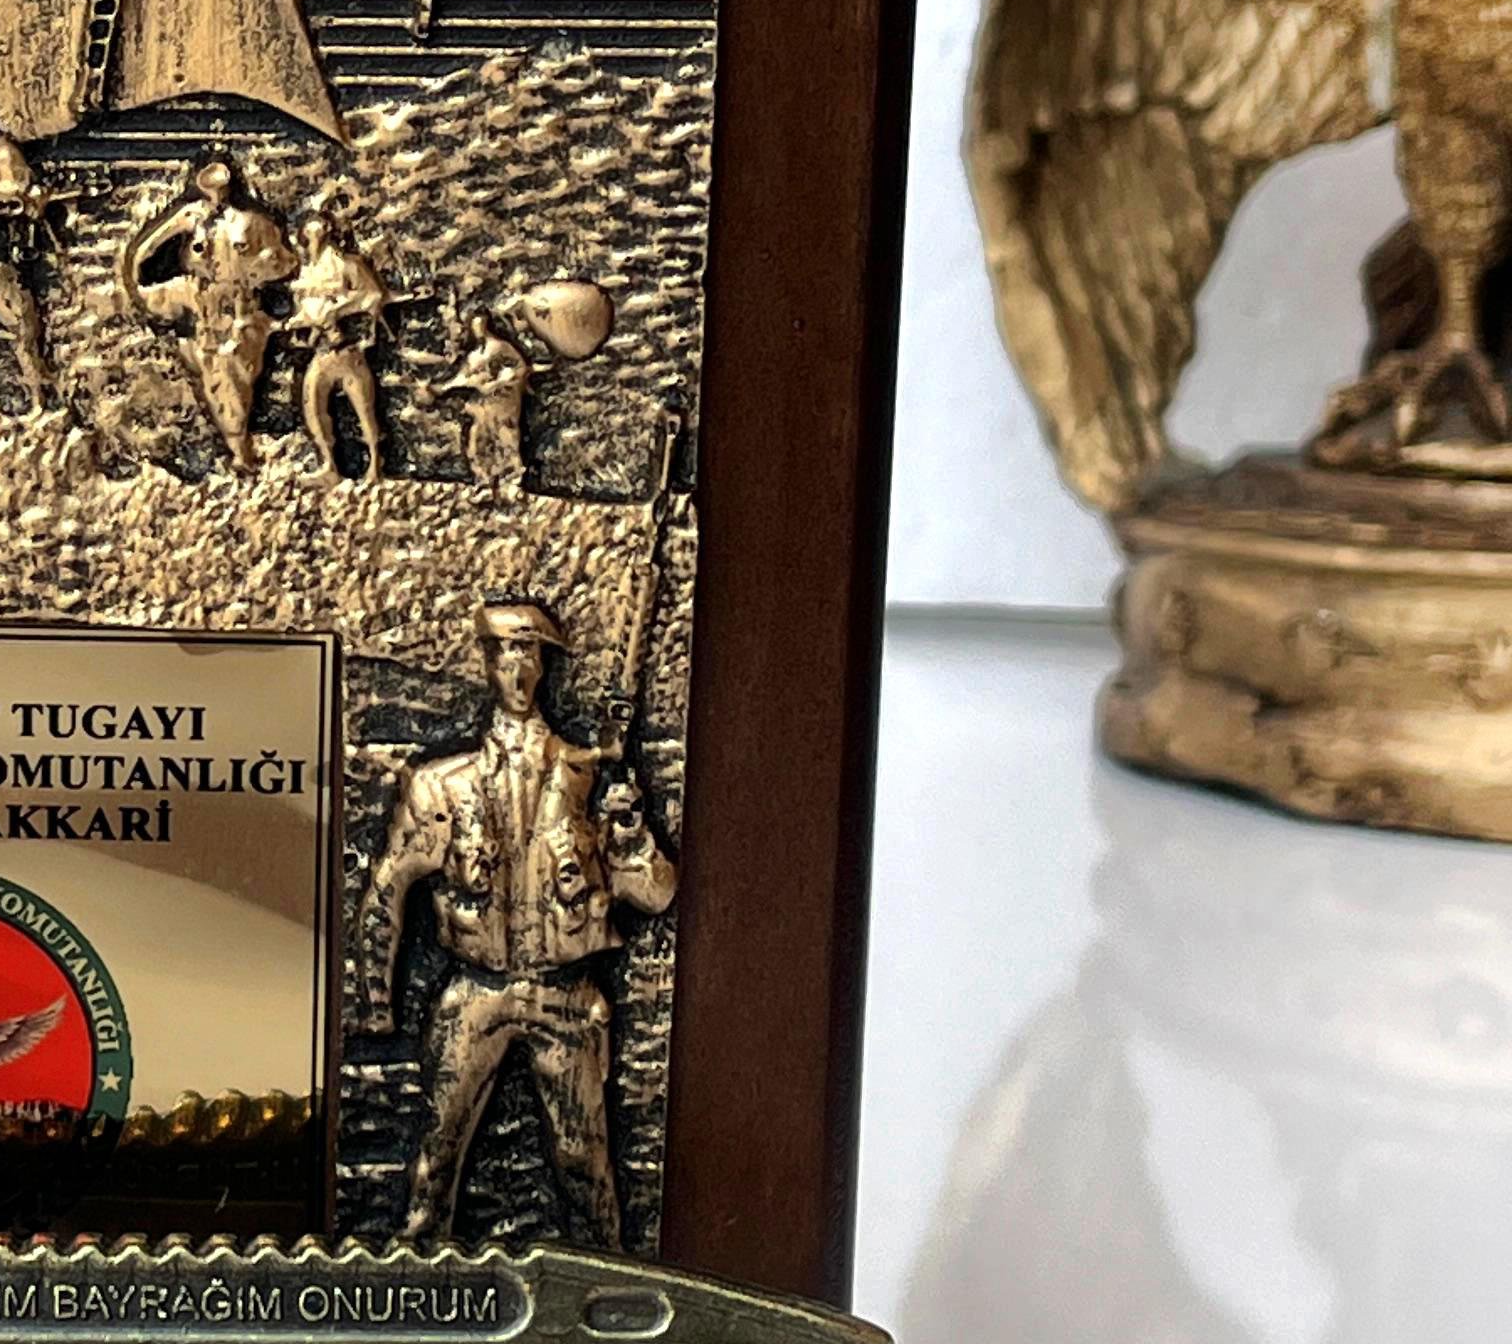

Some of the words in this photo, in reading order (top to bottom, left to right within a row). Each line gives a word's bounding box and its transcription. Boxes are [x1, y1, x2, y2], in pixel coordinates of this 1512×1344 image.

[11, 704, 207, 741] TUGAYI
[52, 1278, 282, 1323] BAYRAĞIM
[297, 1283, 498, 1325] ONURUM
